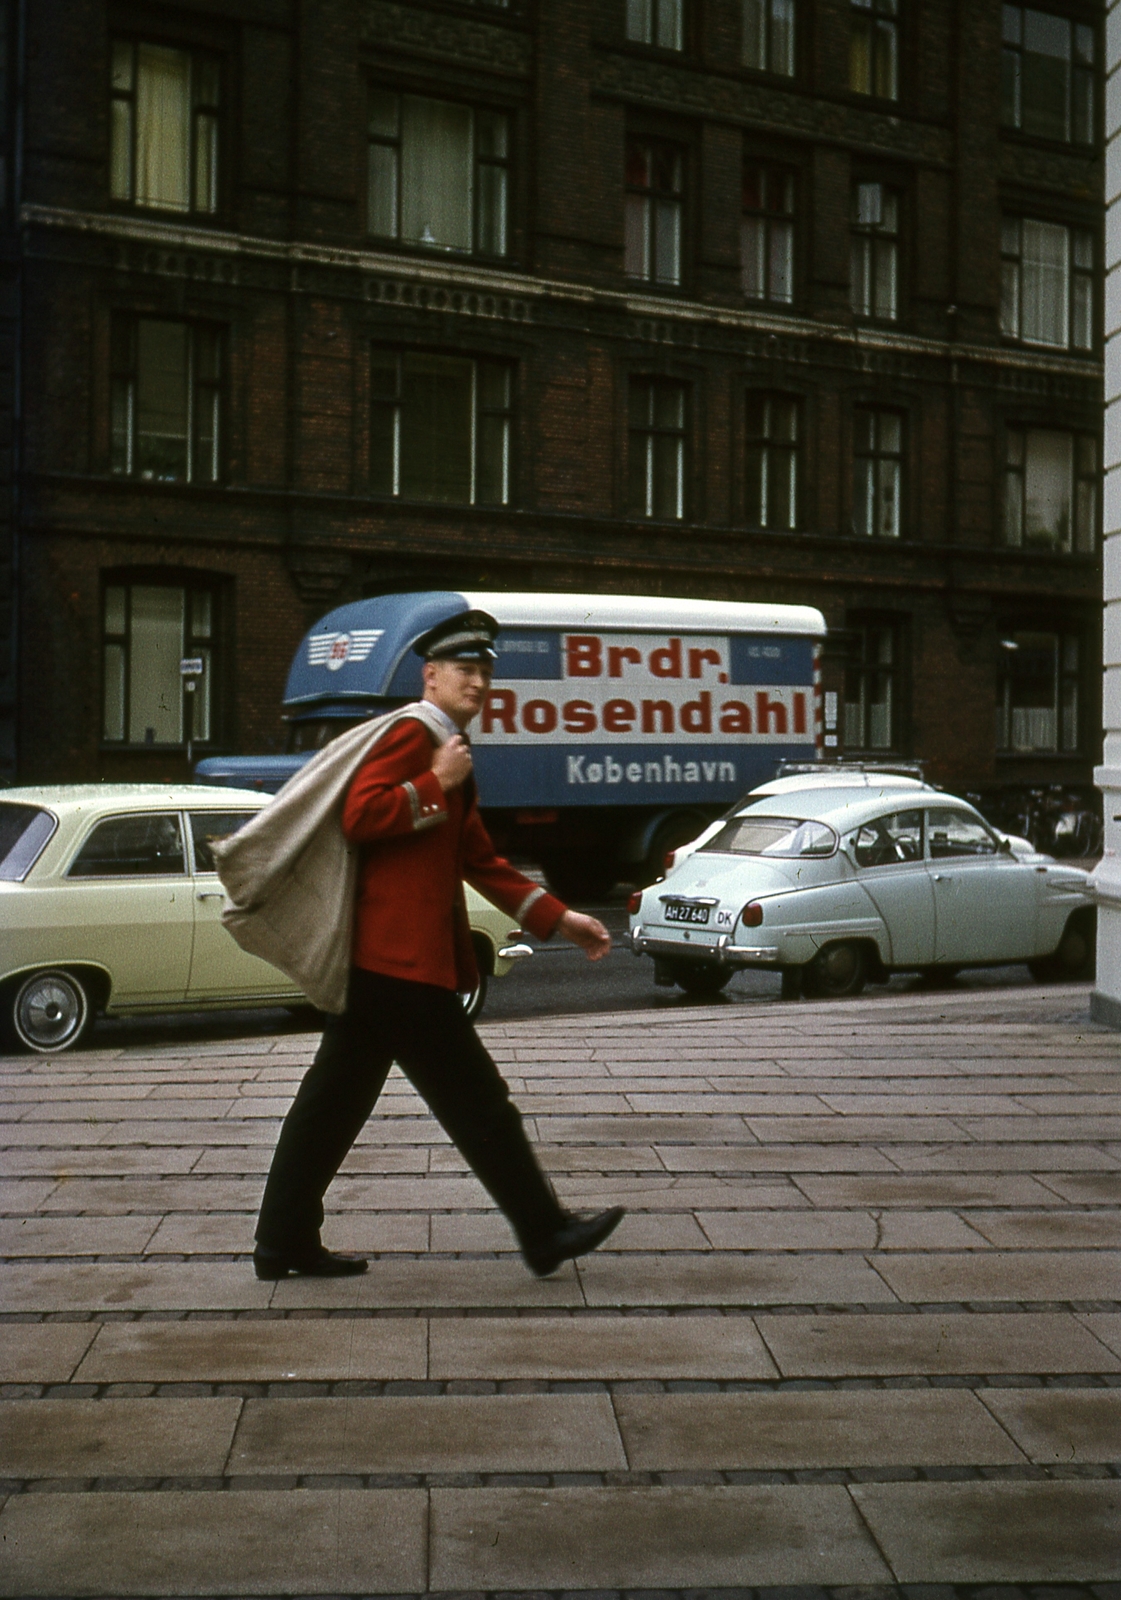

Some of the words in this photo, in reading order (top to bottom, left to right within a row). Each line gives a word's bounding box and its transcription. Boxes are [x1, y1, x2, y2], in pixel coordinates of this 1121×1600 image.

[566, 636, 729, 684] Brdr.
[480, 688, 807, 734] Rosendahl
[566, 755, 737, 783] København
[717, 911, 732, 925] DK
